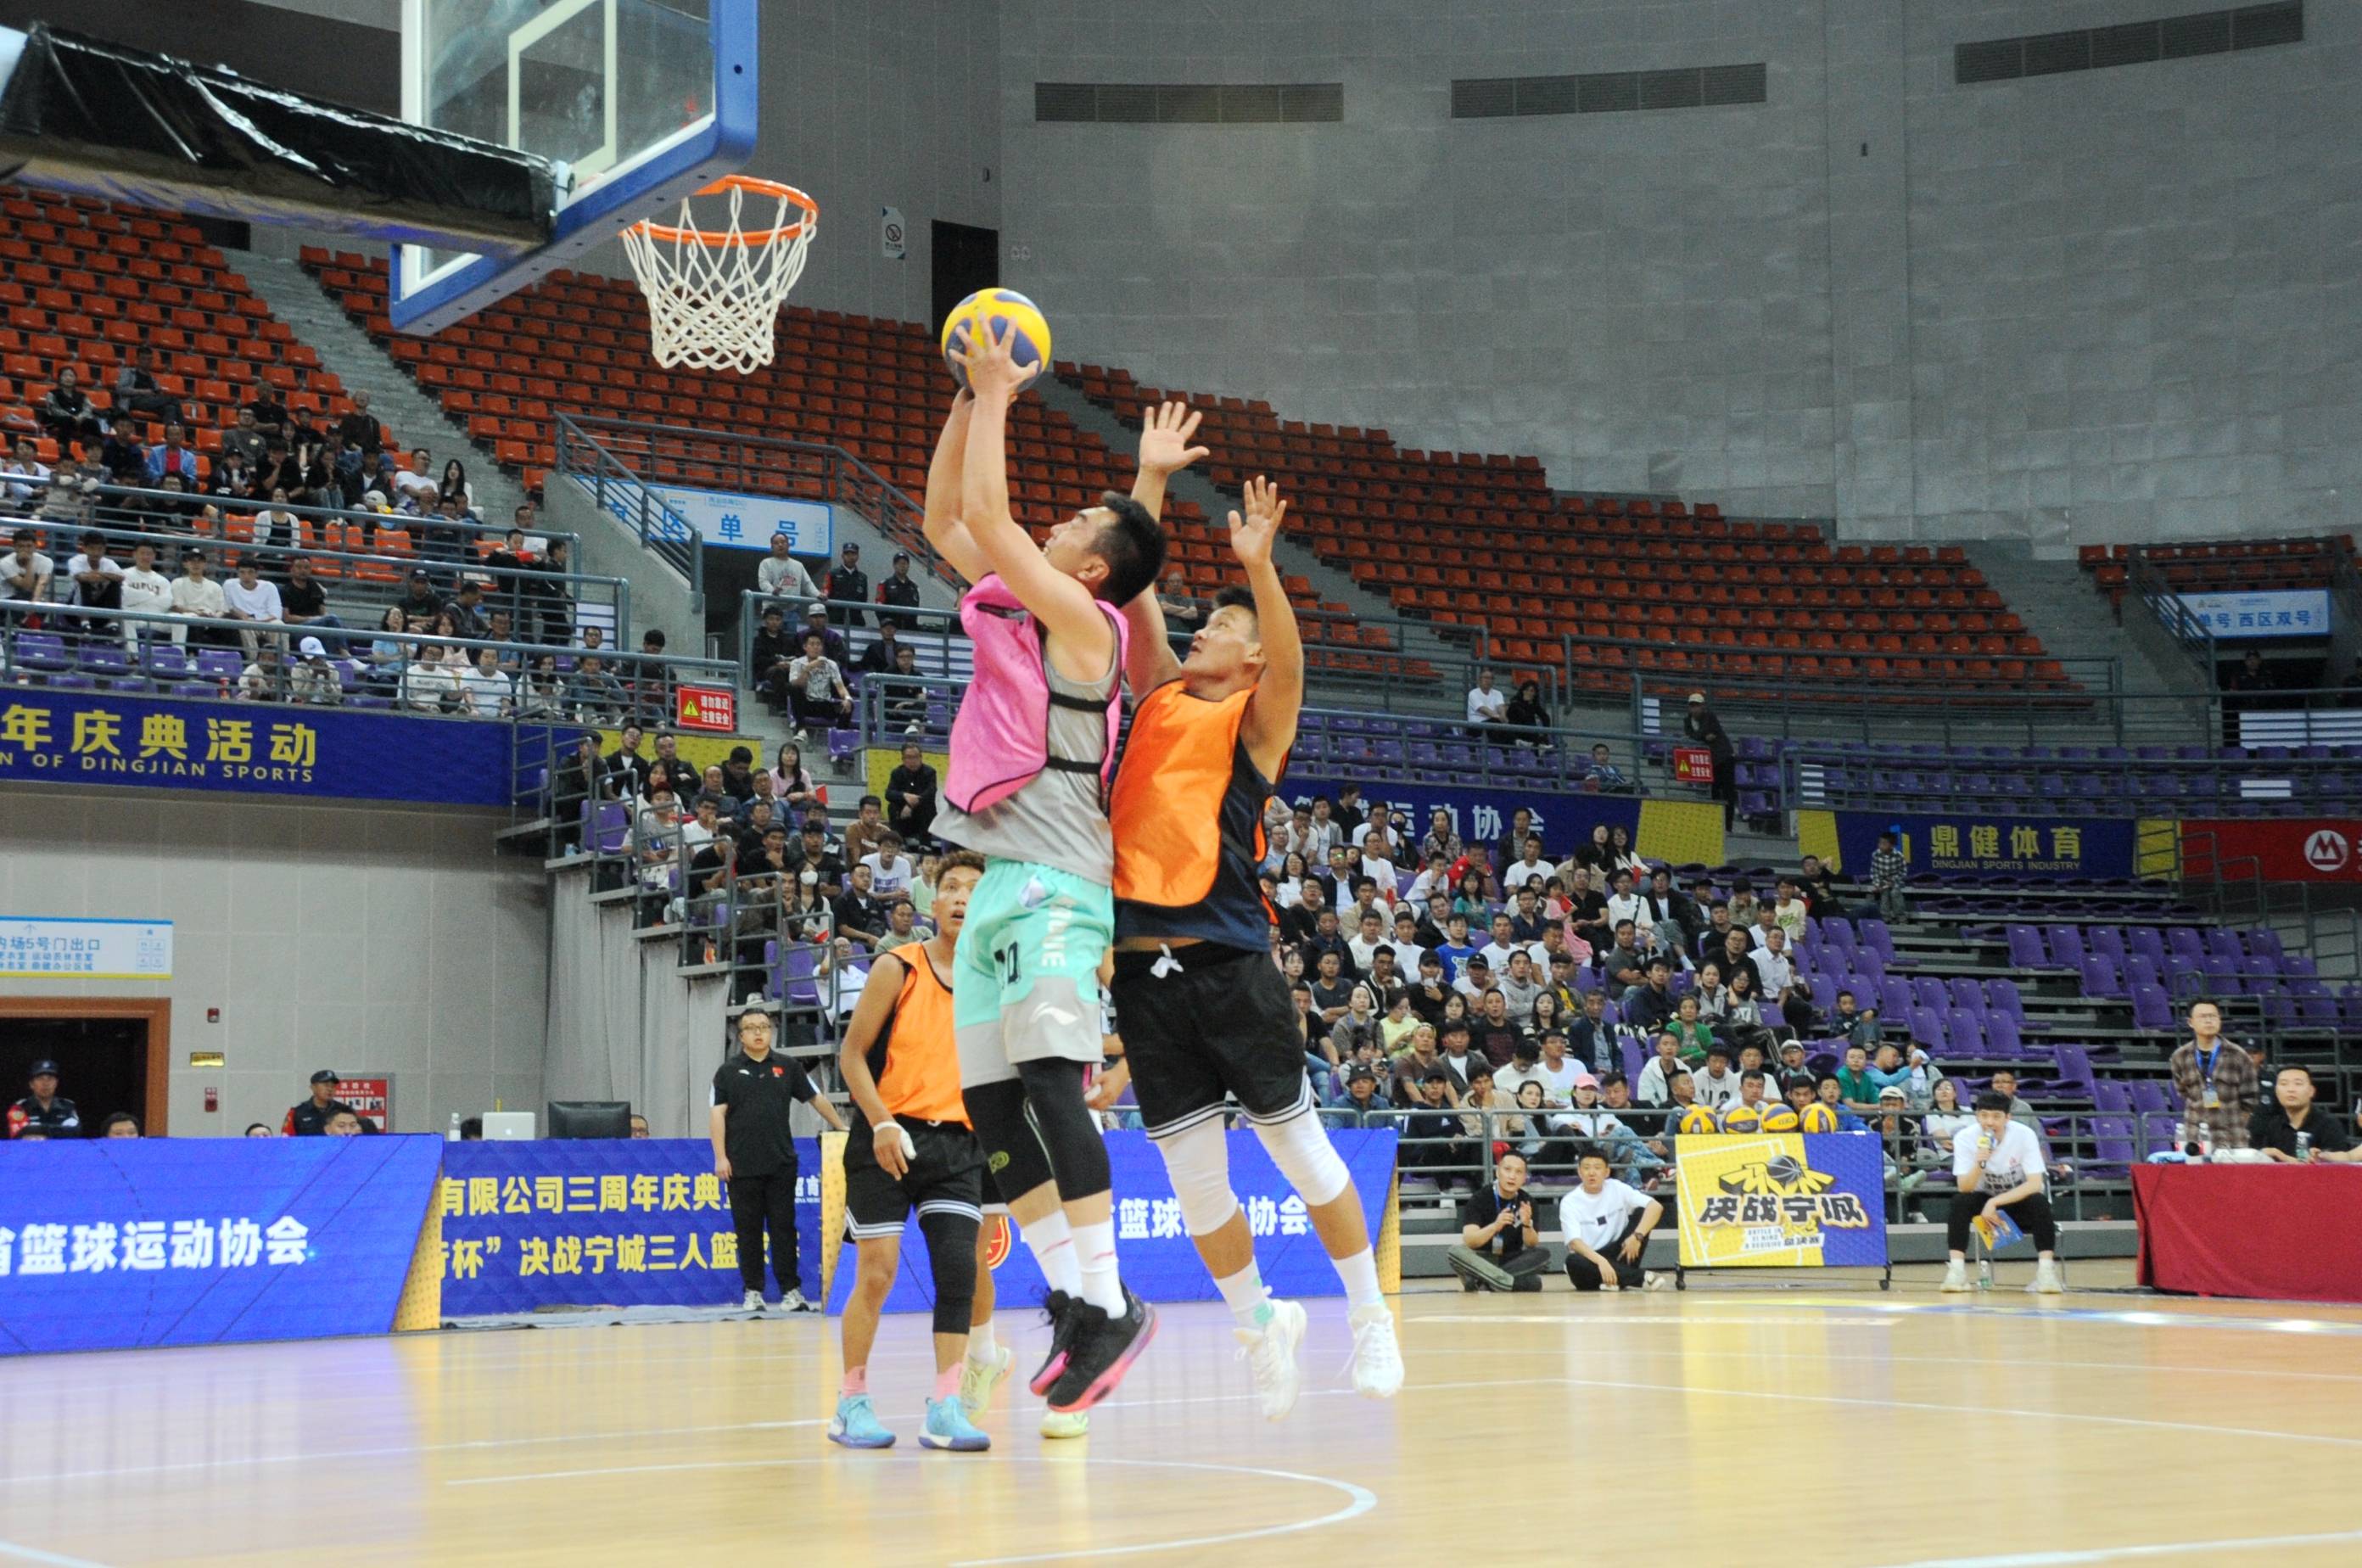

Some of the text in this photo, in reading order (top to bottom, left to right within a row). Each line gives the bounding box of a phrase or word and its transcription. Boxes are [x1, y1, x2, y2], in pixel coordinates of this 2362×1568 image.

[1, 703, 316, 767] 年庆典活动
[31, 753, 64, 768] OF
[81, 755, 206, 776] DINGJIAN
[222, 764, 313, 783] SPORTS
[1931, 824, 2081, 860] 鼎健体育
[1931, 859, 2080, 871] DINGJIAN SPORTS INDUSTRY
[440, 1173, 732, 1218] 有限公司三周年庆典
[1698, 1195, 1865, 1224] 决战宁城
